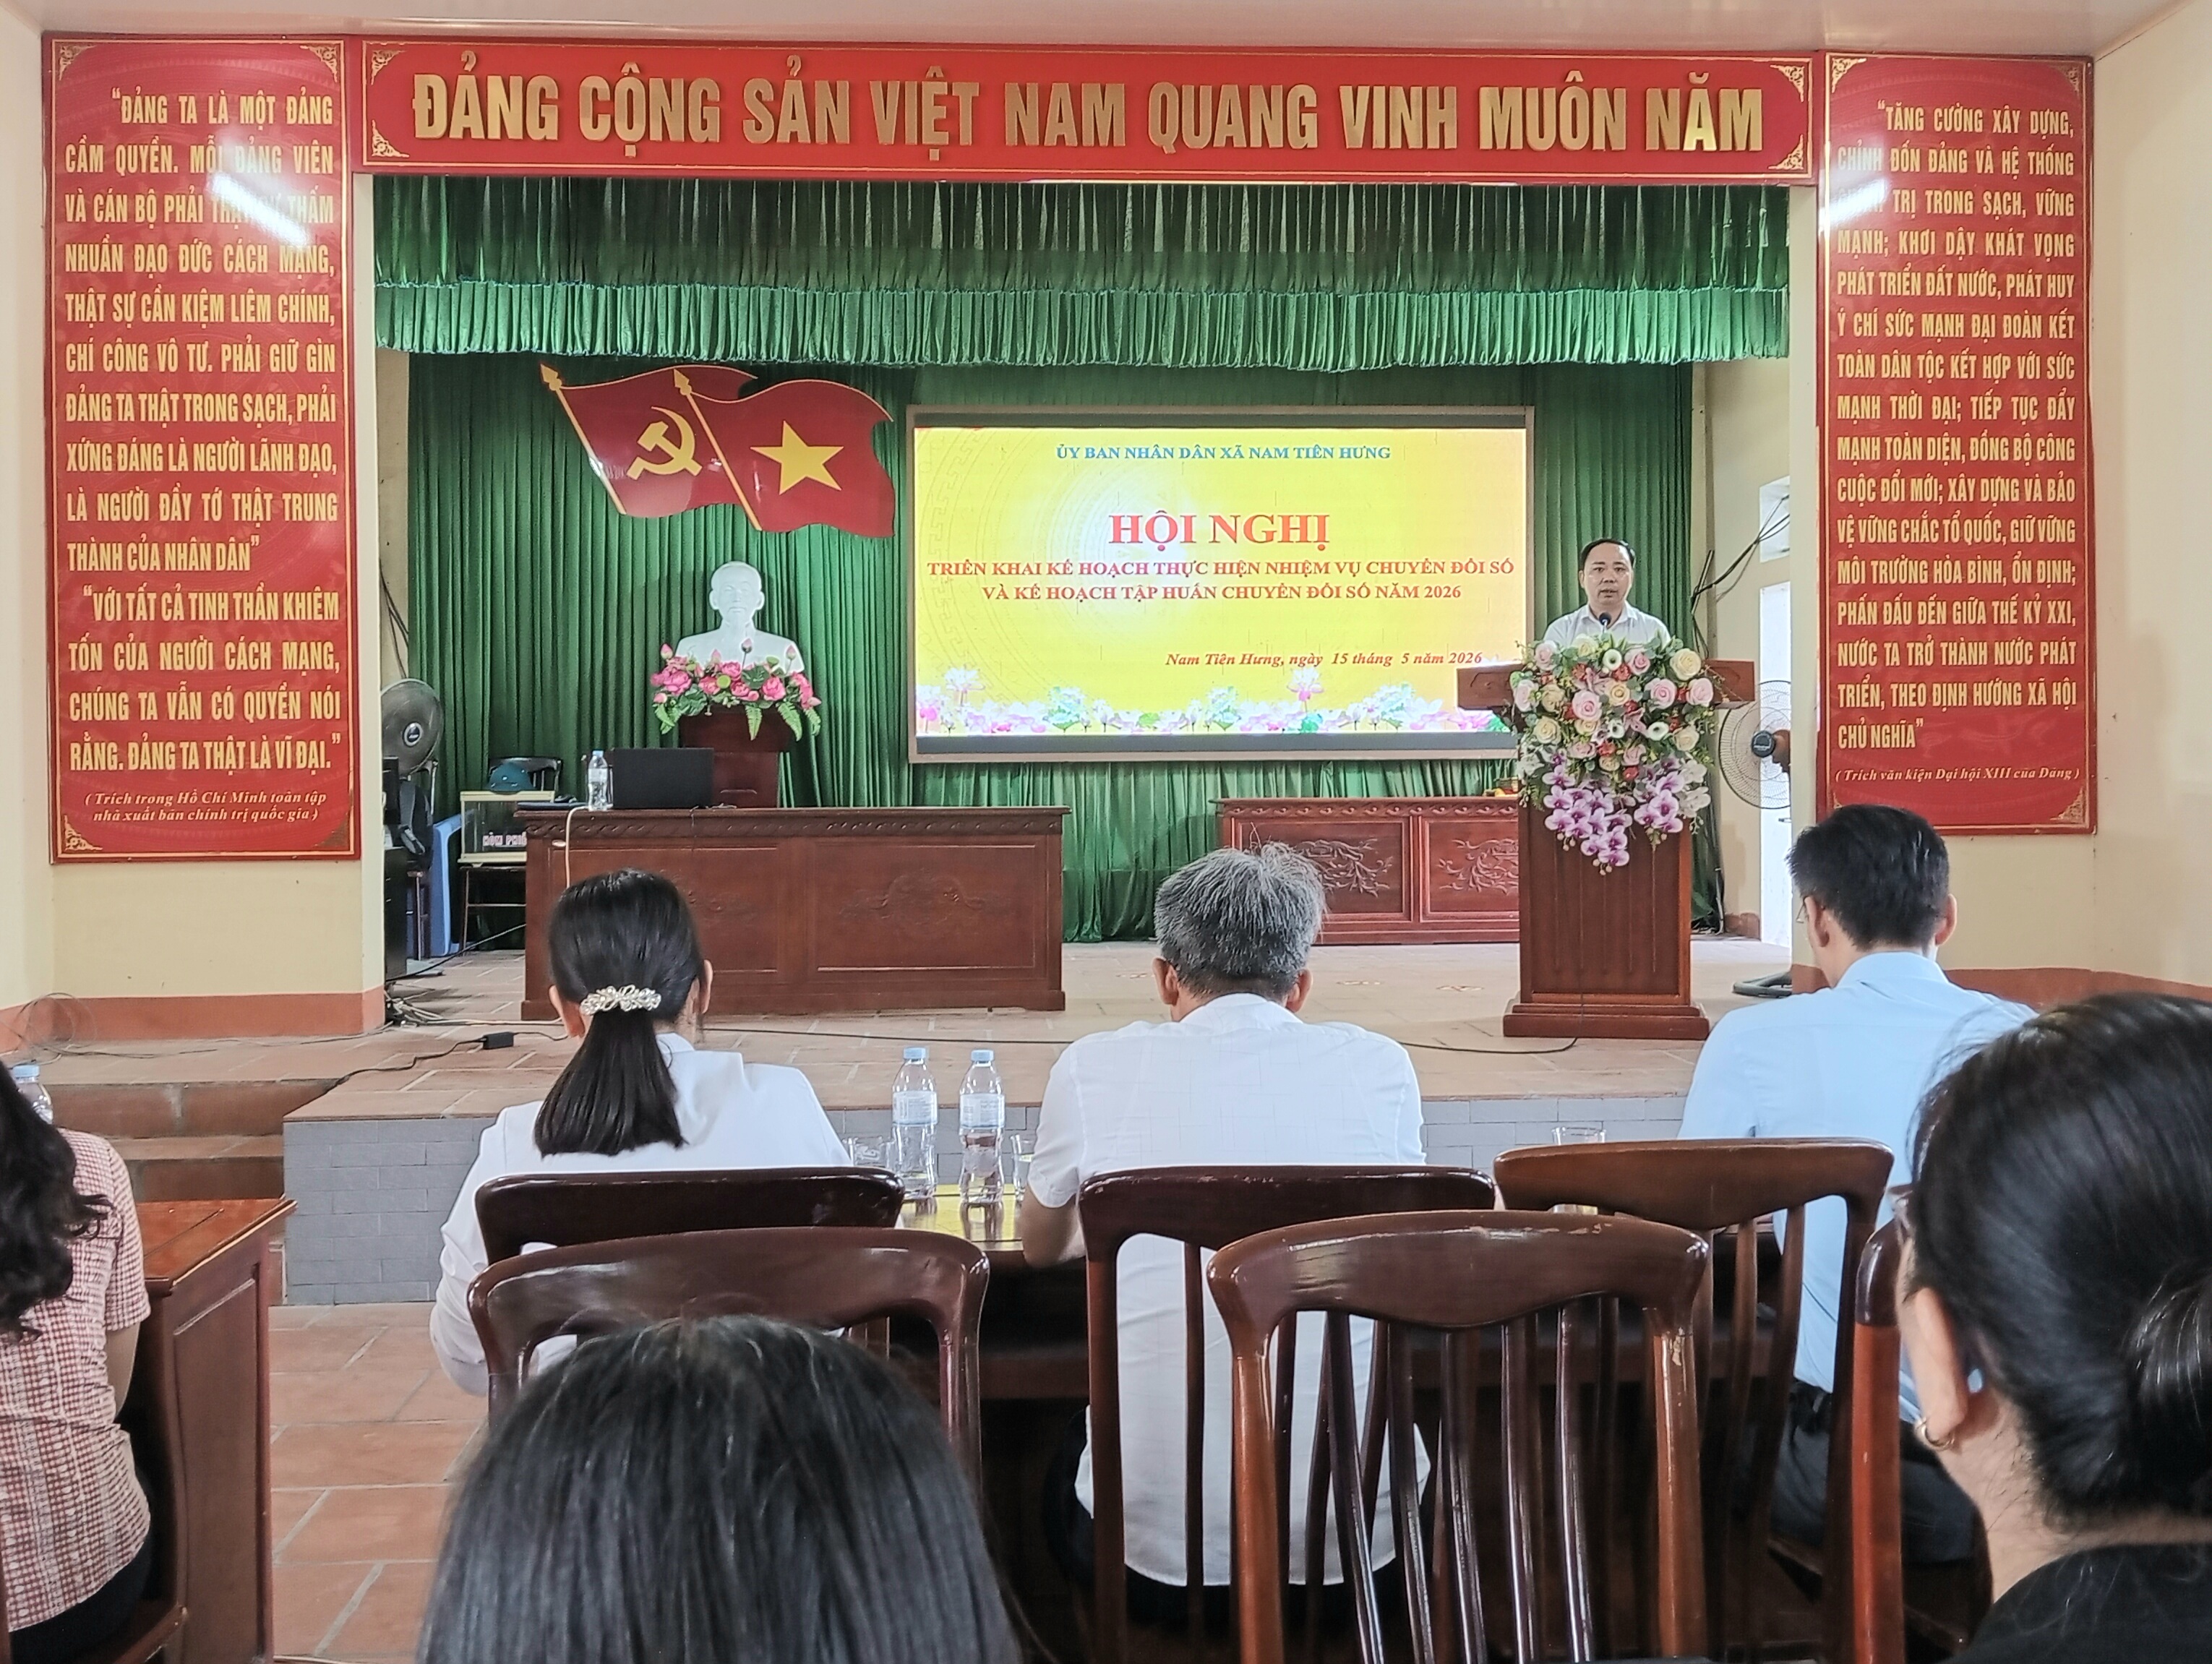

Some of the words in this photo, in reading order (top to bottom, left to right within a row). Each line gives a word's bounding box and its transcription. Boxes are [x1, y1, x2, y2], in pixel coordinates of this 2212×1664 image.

[178, 95, 198, 124] TA
[208, 90, 229, 124] LÀ
[239, 90, 276, 131] MỘT
[286, 86, 333, 125] ĐẢNG
[413, 51, 558, 140] ĐẢNG
[580, 61, 721, 158] CỘNG
[742, 55, 849, 145] SẢN
[870, 66, 980, 161] VIỆT
[1005, 82, 1125, 147] NAM
[1147, 82, 1318, 154] QUANG
[1339, 85, 1457, 149] VINH
[1479, 70, 1626, 151] MUÔN
[1646, 72, 1762, 151] NĂM
[1934, 102, 1983, 133] CƯỜNG
[1992, 105, 2020, 134] XÂY
[64, 134, 105, 173] CẦM
[115, 134, 179, 177] QUYỀN.
[189, 134, 223, 174] MỖI
[234, 134, 283, 174] ĐẢNG
[292, 139, 334, 175] VIÊN
[1838, 228, 1889, 260] MẠNH;
[1899, 228, 1936, 255] KHƠI
[1945, 226, 1976, 261] DẬY
[1985, 227, 2025, 257] KHÁT
[2033, 233, 2075, 262] VỌNG
[64, 287, 106, 329] THẬT
[112, 291, 137, 329] SỰ
[141, 283, 176, 322] CẦN
[181, 288, 225, 329] KIỆM
[231, 288, 271, 322] LIÊM
[278, 288, 335, 327] CHÍNH,
[1837, 307, 1846, 337] Ý
[1853, 307, 1878, 337] CHÍ
[1885, 308, 1914, 338] SỨC
[1921, 313, 1965, 343] MẠNH
[1971, 314, 1996, 343] ĐẠI
[2002, 309, 2042, 339] ĐOÀN
[2049, 307, 2075, 339] KẾT
[65, 383, 112, 422] ĐẢNG
[115, 393, 135, 422] TA
[137, 387, 180, 429] THẬT
[182, 393, 239, 422] TRONG
[242, 393, 293, 429] SẠCH,
[296, 384, 336, 422] PHẢI
[1057, 444, 1080, 458] ỦY
[1084, 447, 1120, 458] BAN
[1125, 444, 1174, 458] NHÂN
[1179, 444, 1216, 458] DÂN
[1220, 445, 1245, 458] XÃ
[1249, 447, 1289, 458] NAM
[1293, 444, 1334, 458] TIÊN
[1339, 446, 1391, 458] HƯNG
[1837, 436, 1881, 466] MẠNH
[1884, 432, 1923, 461] TOÀN
[1926, 432, 1965, 466] DIỆN,
[1969, 429, 2010, 462] ĐỒNG
[2012, 432, 2033, 467] BỘ
[2036, 432, 2075, 462] CÔNG
[67, 486, 87, 522] LÀ
[97, 486, 150, 522] NGƯỜI
[158, 482, 192, 522] ĐẦY
[201, 486, 223, 522] TỚ
[231, 486, 273, 528] THẬT
[282, 492, 338, 522] TRUNG
[1108, 510, 1196, 552] HỘI
[1209, 514, 1330, 552] NGHỊ
[992, 562, 1042, 575] KHAI
[1047, 559, 1073, 575] KẾ
[1079, 562, 1149, 578] HOẠCH
[1153, 560, 1208, 578] THỰC
[1213, 559, 1261, 578] HIỆN
[1265, 559, 1332, 578] NHIỆM
[1334, 561, 1361, 578] VỤ
[1490, 557, 1514, 575] SỐ
[1837, 555, 1866, 585] MÔI
[1870, 554, 1929, 585] TRƯỜNG
[1933, 554, 1963, 584] HÒA
[1967, 554, 2007, 587] BÌNH,
[2012, 550, 2032, 584] ỔN
[2036, 559, 2076, 589] ĐỊNH;
[125, 582, 157, 622] TẤT
[161, 583, 185, 622] CẢ
[188, 592, 229, 621] TINH
[232, 582, 279, 621] THẦN
[283, 586, 339, 621] KHIÊM
[982, 583, 1010, 600] VÀ
[1014, 583, 1041, 600] KẾ
[1046, 586, 1117, 603] HOẠCH
[1121, 584, 1158, 602] TẬP
[1162, 583, 1217, 600] HUẤN
[1346, 582, 1371, 599] SỐ
[1375, 583, 1420, 599] NĂM
[1424, 586, 1461, 599] 2026
[1165, 653, 1200, 665] Nam
[1205, 653, 1235, 665] Tiên
[1239, 653, 1285, 666] Hưng,
[1289, 653, 1324, 667] ngày
[1332, 653, 1349, 664] 15
[1353, 652, 1393, 666] tháng
[1401, 653, 1410, 664] 5
[1413, 653, 1444, 664] năm
[1448, 652, 1483, 664] 2026
[1838, 637, 1878, 667] NƯỚC
[1883, 642, 1900, 666] TA
[1906, 634, 1934, 666] TRỞ
[1939, 637, 1988, 666] THÀNH
[1994, 636, 2033, 666] NƯỚC
[2040, 636, 2077, 665] PHÁT
[127, 732, 176, 771] ĐẢNG
[179, 741, 200, 770] TA
[202, 734, 247, 776] THẬT
[250, 734, 272, 770] LÀ
[275, 735, 293, 769] VĨ
[1844, 768, 1877, 781] Trích
[1960, 768, 1981, 782] hội
[1983, 767, 2012, 779] XIII
[95, 792, 132, 805] Trích
[135, 794, 173, 807] trong
[177, 789, 199, 804] Hồ
[202, 791, 228, 804] Chí
[229, 791, 267, 803] Minh
[304, 790, 327, 806] tập
[122, 806, 155, 821] xuất
[187, 807, 228, 820] chính
[231, 807, 249, 823] trị
[251, 804, 285, 823] quốc
[287, 807, 309, 823] gia
